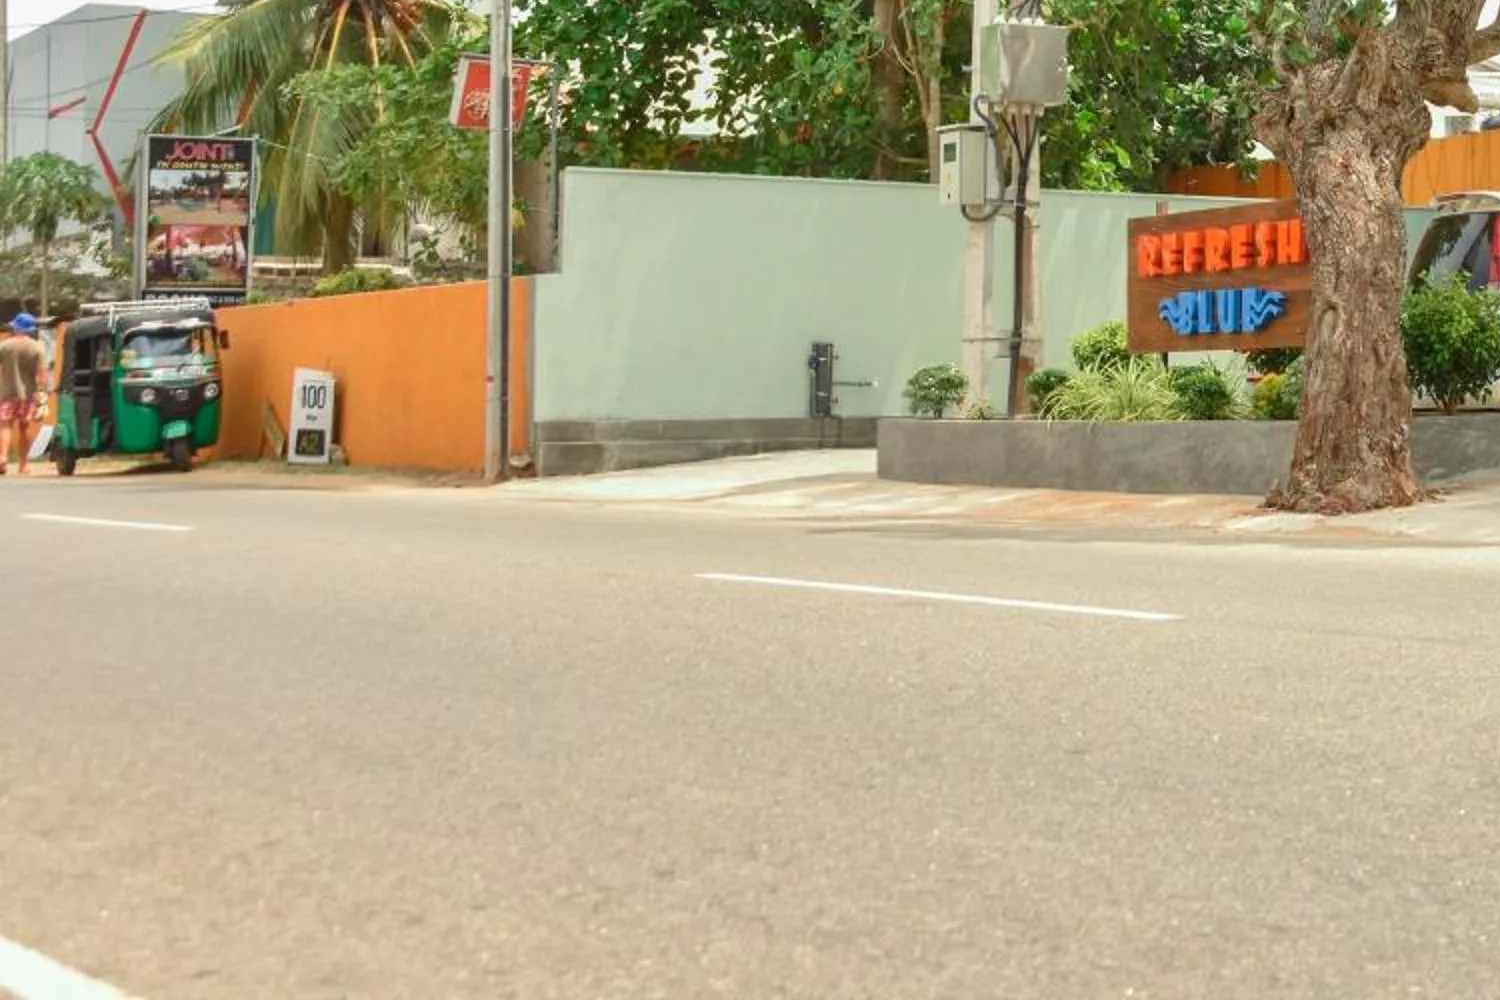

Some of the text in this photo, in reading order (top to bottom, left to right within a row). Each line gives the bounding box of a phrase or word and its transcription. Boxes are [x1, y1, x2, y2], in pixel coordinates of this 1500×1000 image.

[1136, 218, 1308, 278] REFRESH
[1158, 287, 1288, 336] BLUE
[302, 385, 327, 409] 100
